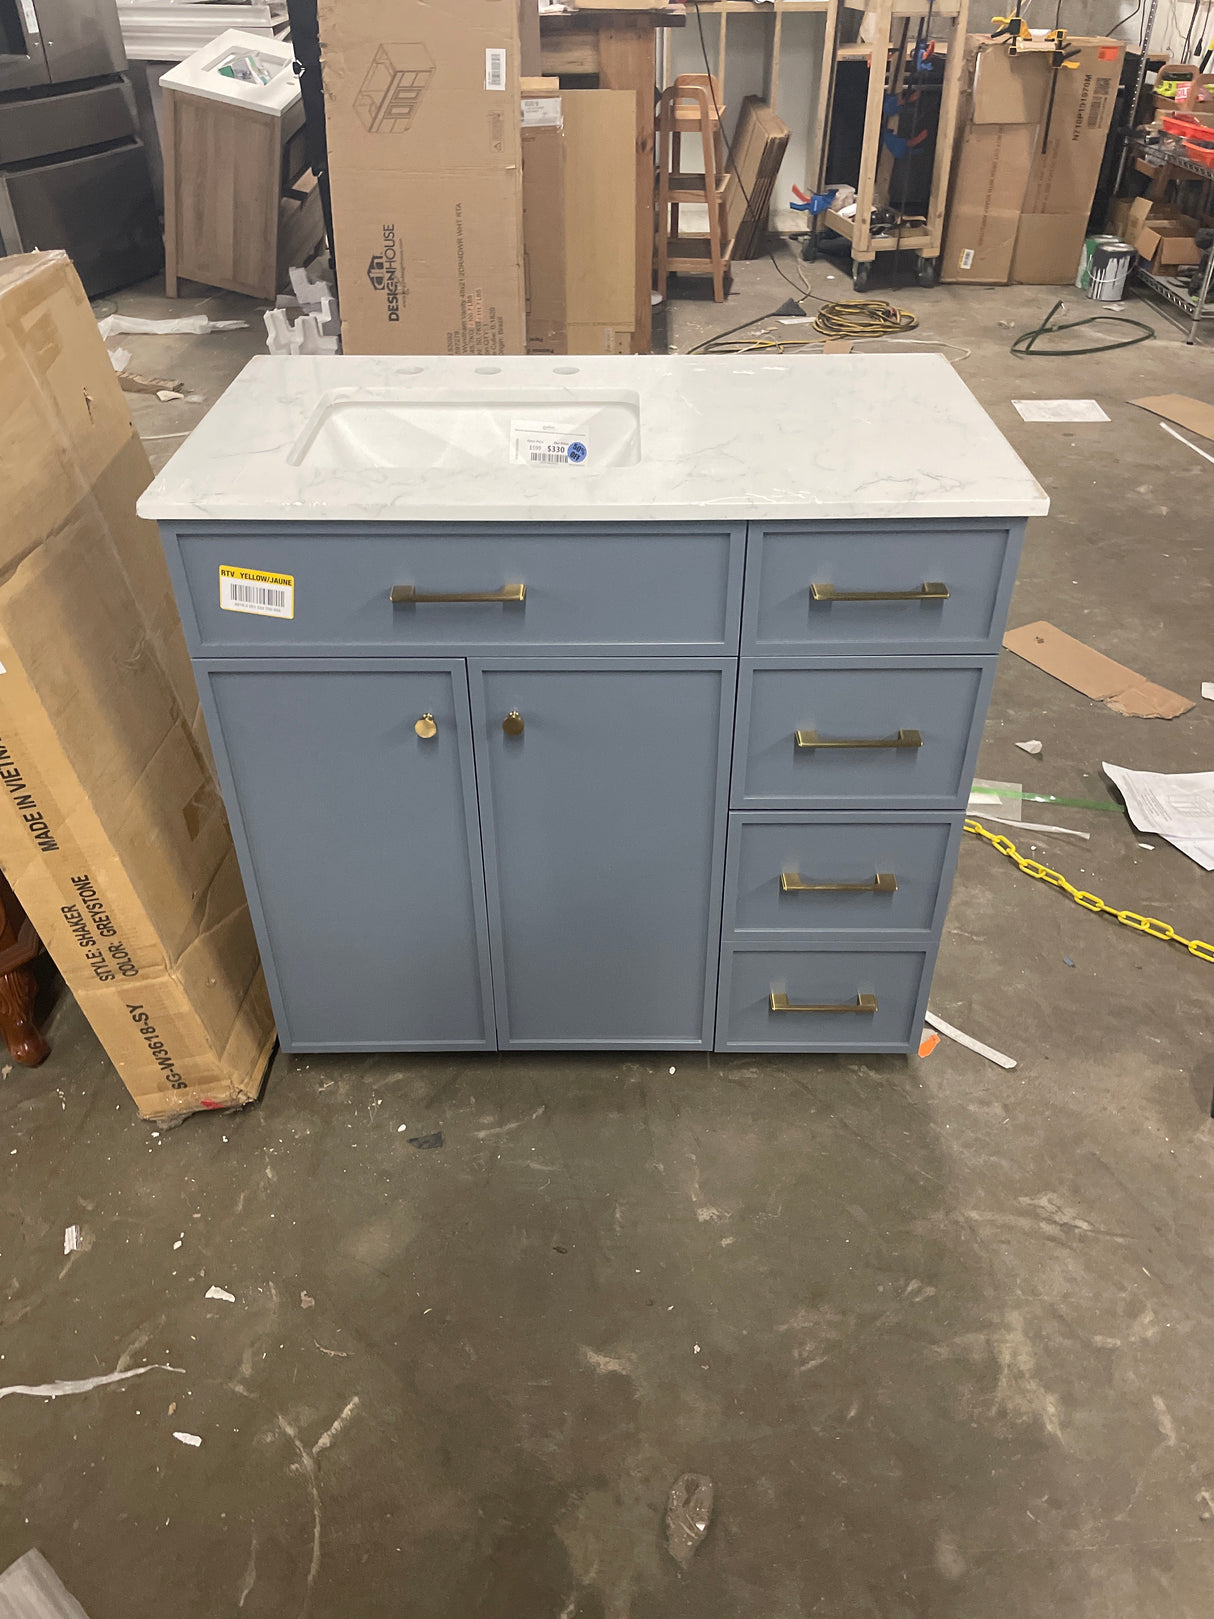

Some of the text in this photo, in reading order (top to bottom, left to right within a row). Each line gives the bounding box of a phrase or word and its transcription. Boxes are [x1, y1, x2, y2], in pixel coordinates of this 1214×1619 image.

[383, 224, 400, 322] DESIGNHOUSE
[547, 445, 565, 453] $330
[570, 451, 581, 461] OFF
[221, 569, 293, 587] RTV YELLOW/JAUNE
[0, 737, 60, 852] MADE IN VIETN
[61, 904, 116, 982] STYLE: SHAKER
[70, 874, 138, 977] COLOR: GREYSTONE
[126, 1003, 188, 1090] SG-W3618-SY
